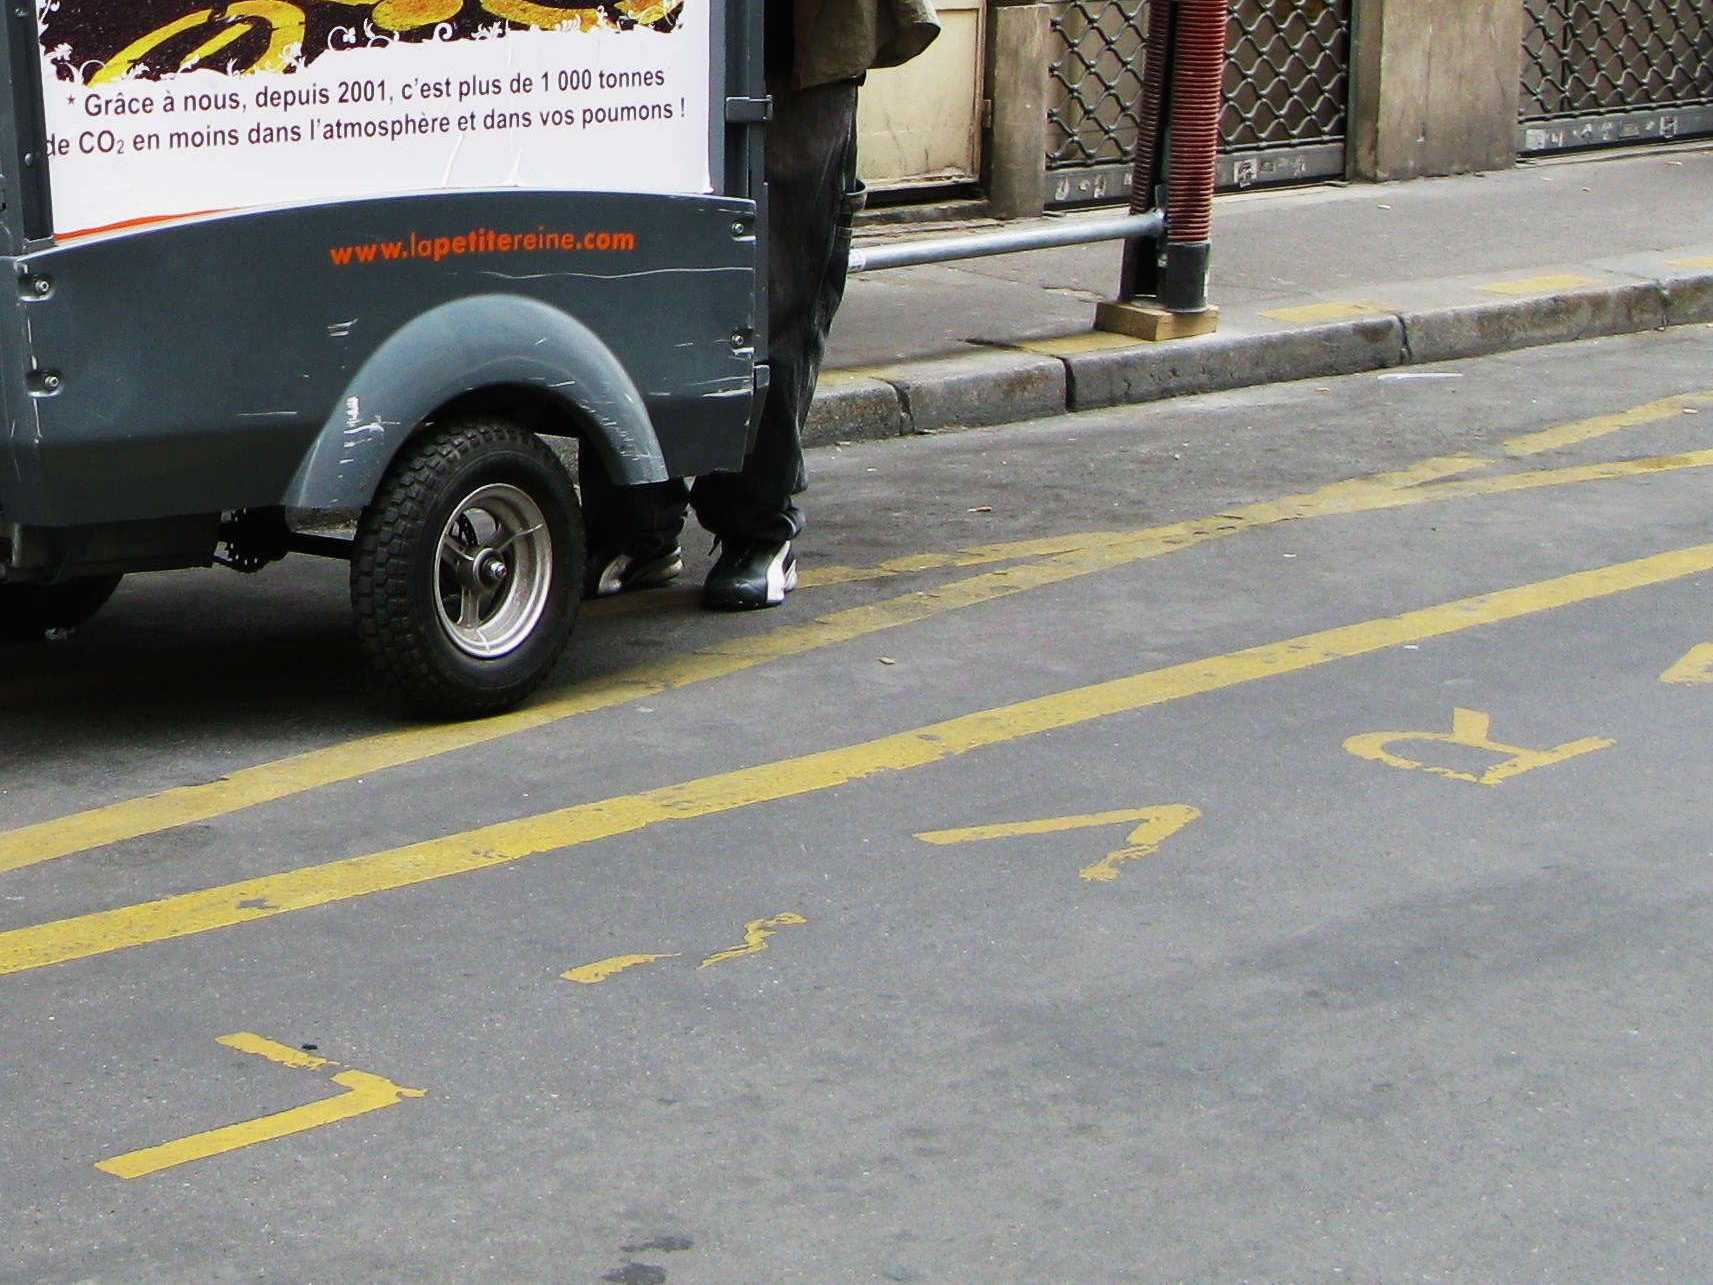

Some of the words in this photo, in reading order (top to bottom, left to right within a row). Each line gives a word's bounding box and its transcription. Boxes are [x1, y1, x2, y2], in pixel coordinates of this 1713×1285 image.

[84, 92, 154, 117] Grâce
[162, 89, 175, 113] à
[184, 92, 247, 112] nous,
[255, 85, 330, 112] depuis
[338, 79, 393, 104] 2001,
[401, 77, 452, 100] c'est
[458, 75, 502, 102] plus
[509, 72, 533, 94] de
[541, 71, 549, 92] 1
[558, 68, 592, 92] 000
[598, 70, 665, 89] tonnes
[132, 133, 160, 151] en
[169, 128, 240, 149] moins
[247, 122, 302, 145] dans
[310, 113, 451, 141] l'atmosphère
[457, 111, 476, 132] et
[483, 108, 532, 130] dans
[539, 109, 575, 126] vos
[582, 103, 674, 129] poumons
[679, 97, 686, 117] !
[329, 225, 636, 265] www.lapetitereine.com
